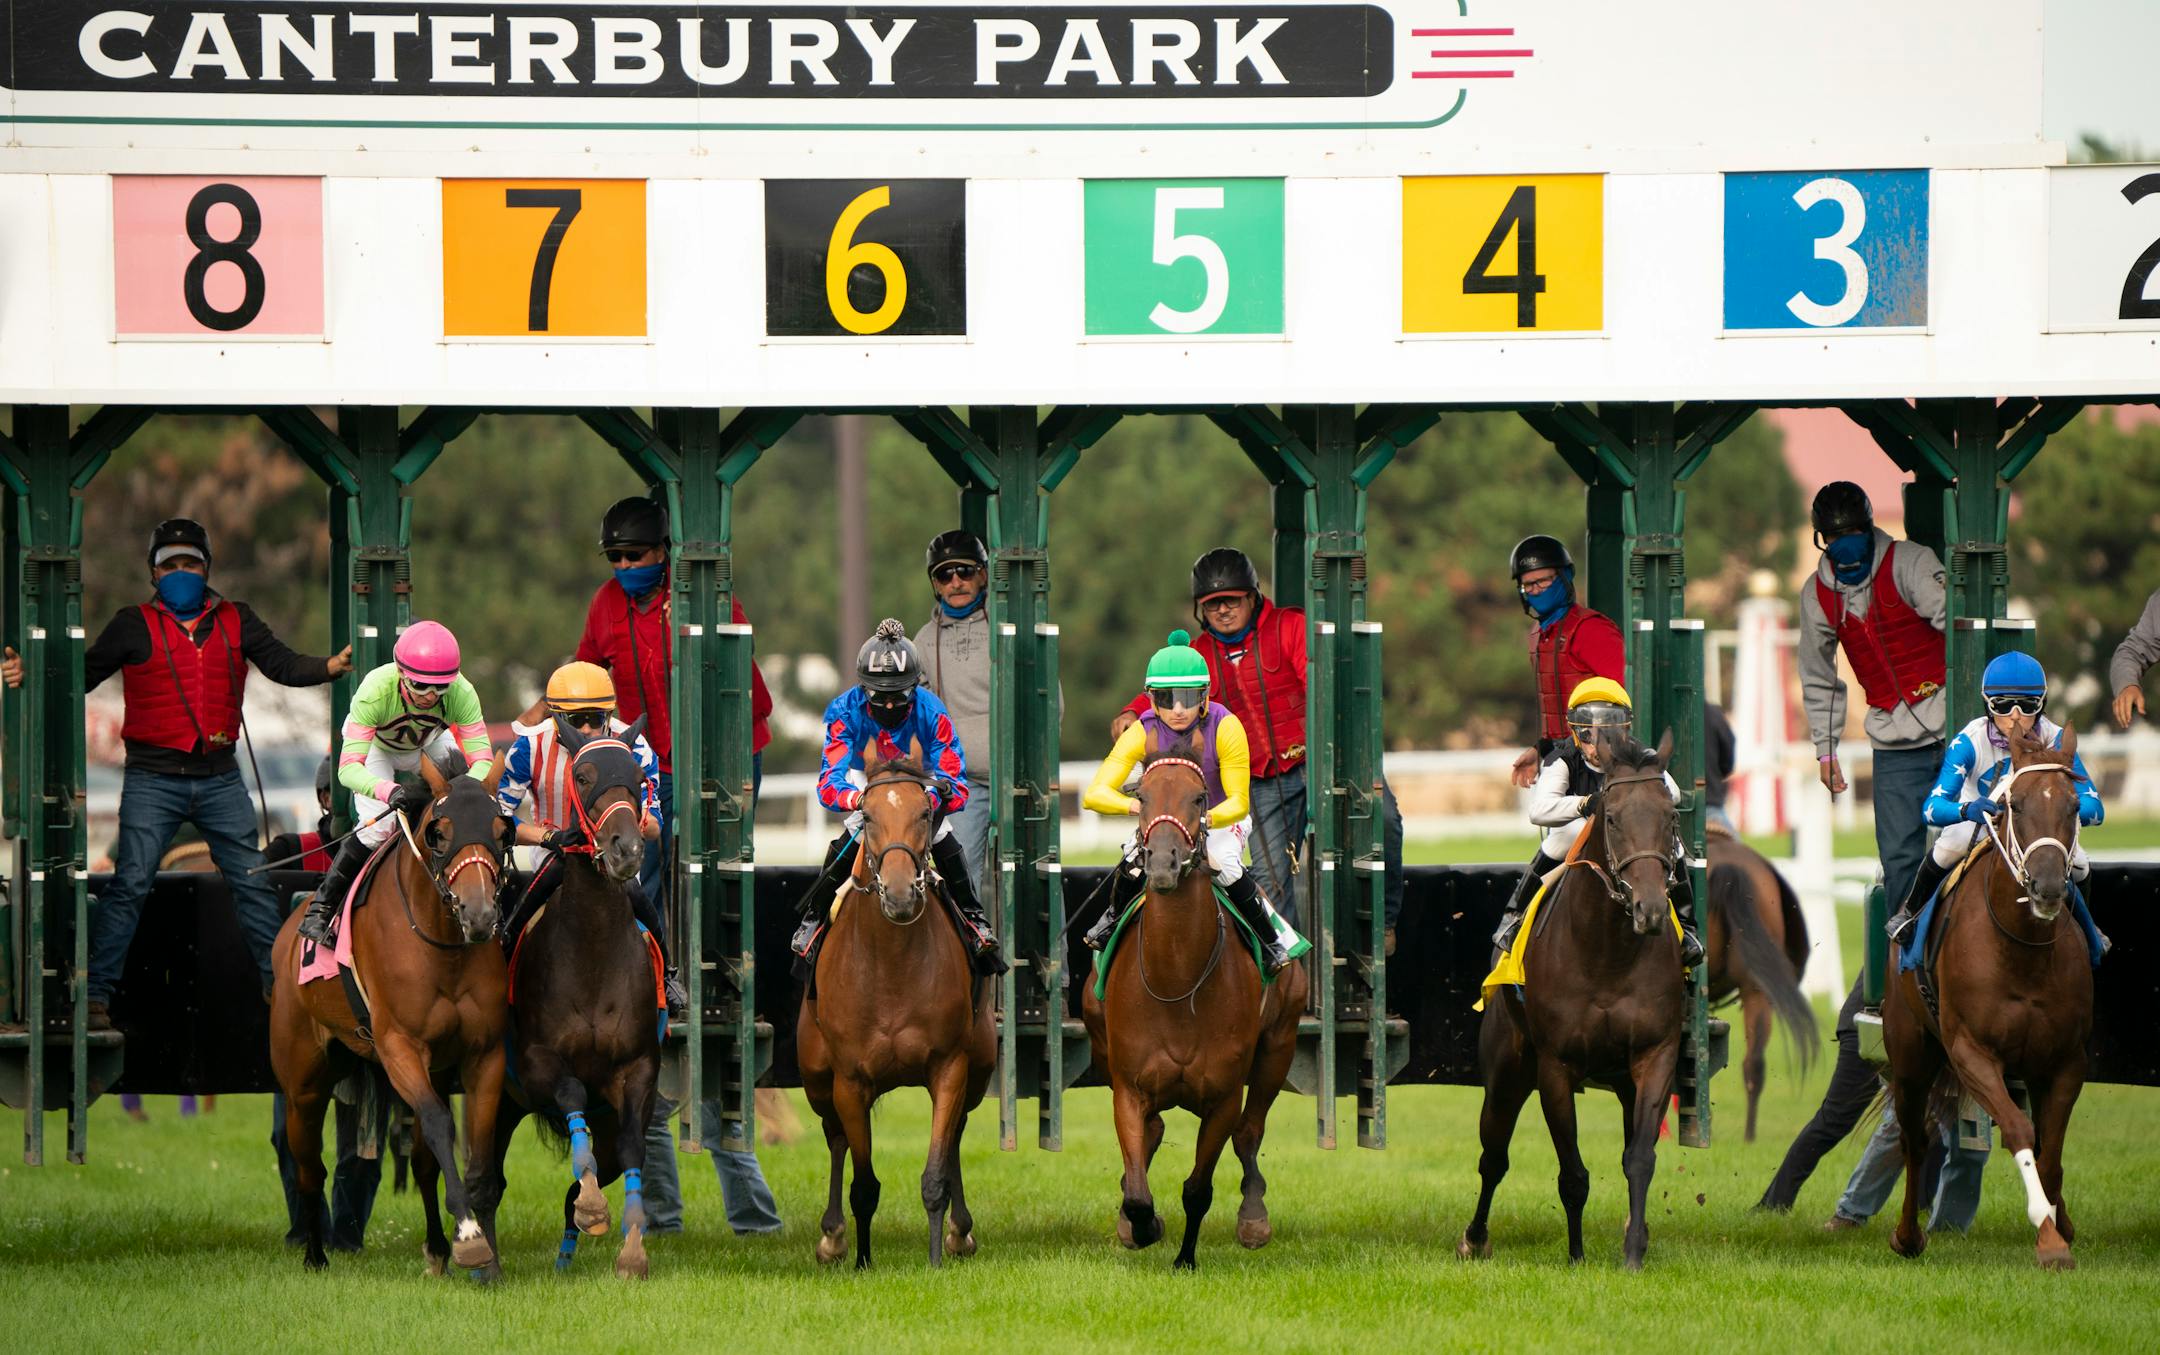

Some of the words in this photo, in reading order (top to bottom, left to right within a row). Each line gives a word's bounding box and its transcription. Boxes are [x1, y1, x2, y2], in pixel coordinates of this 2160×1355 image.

[77, 10, 917, 86] CANTERBURY
[973, 18, 1290, 86] PARK
[184, 183, 266, 331] 8
[505, 189, 582, 332] 7
[825, 185, 908, 334] 6
[1148, 187, 1230, 333] 5
[1462, 186, 1546, 328] 4
[1786, 177, 1869, 327] 3
